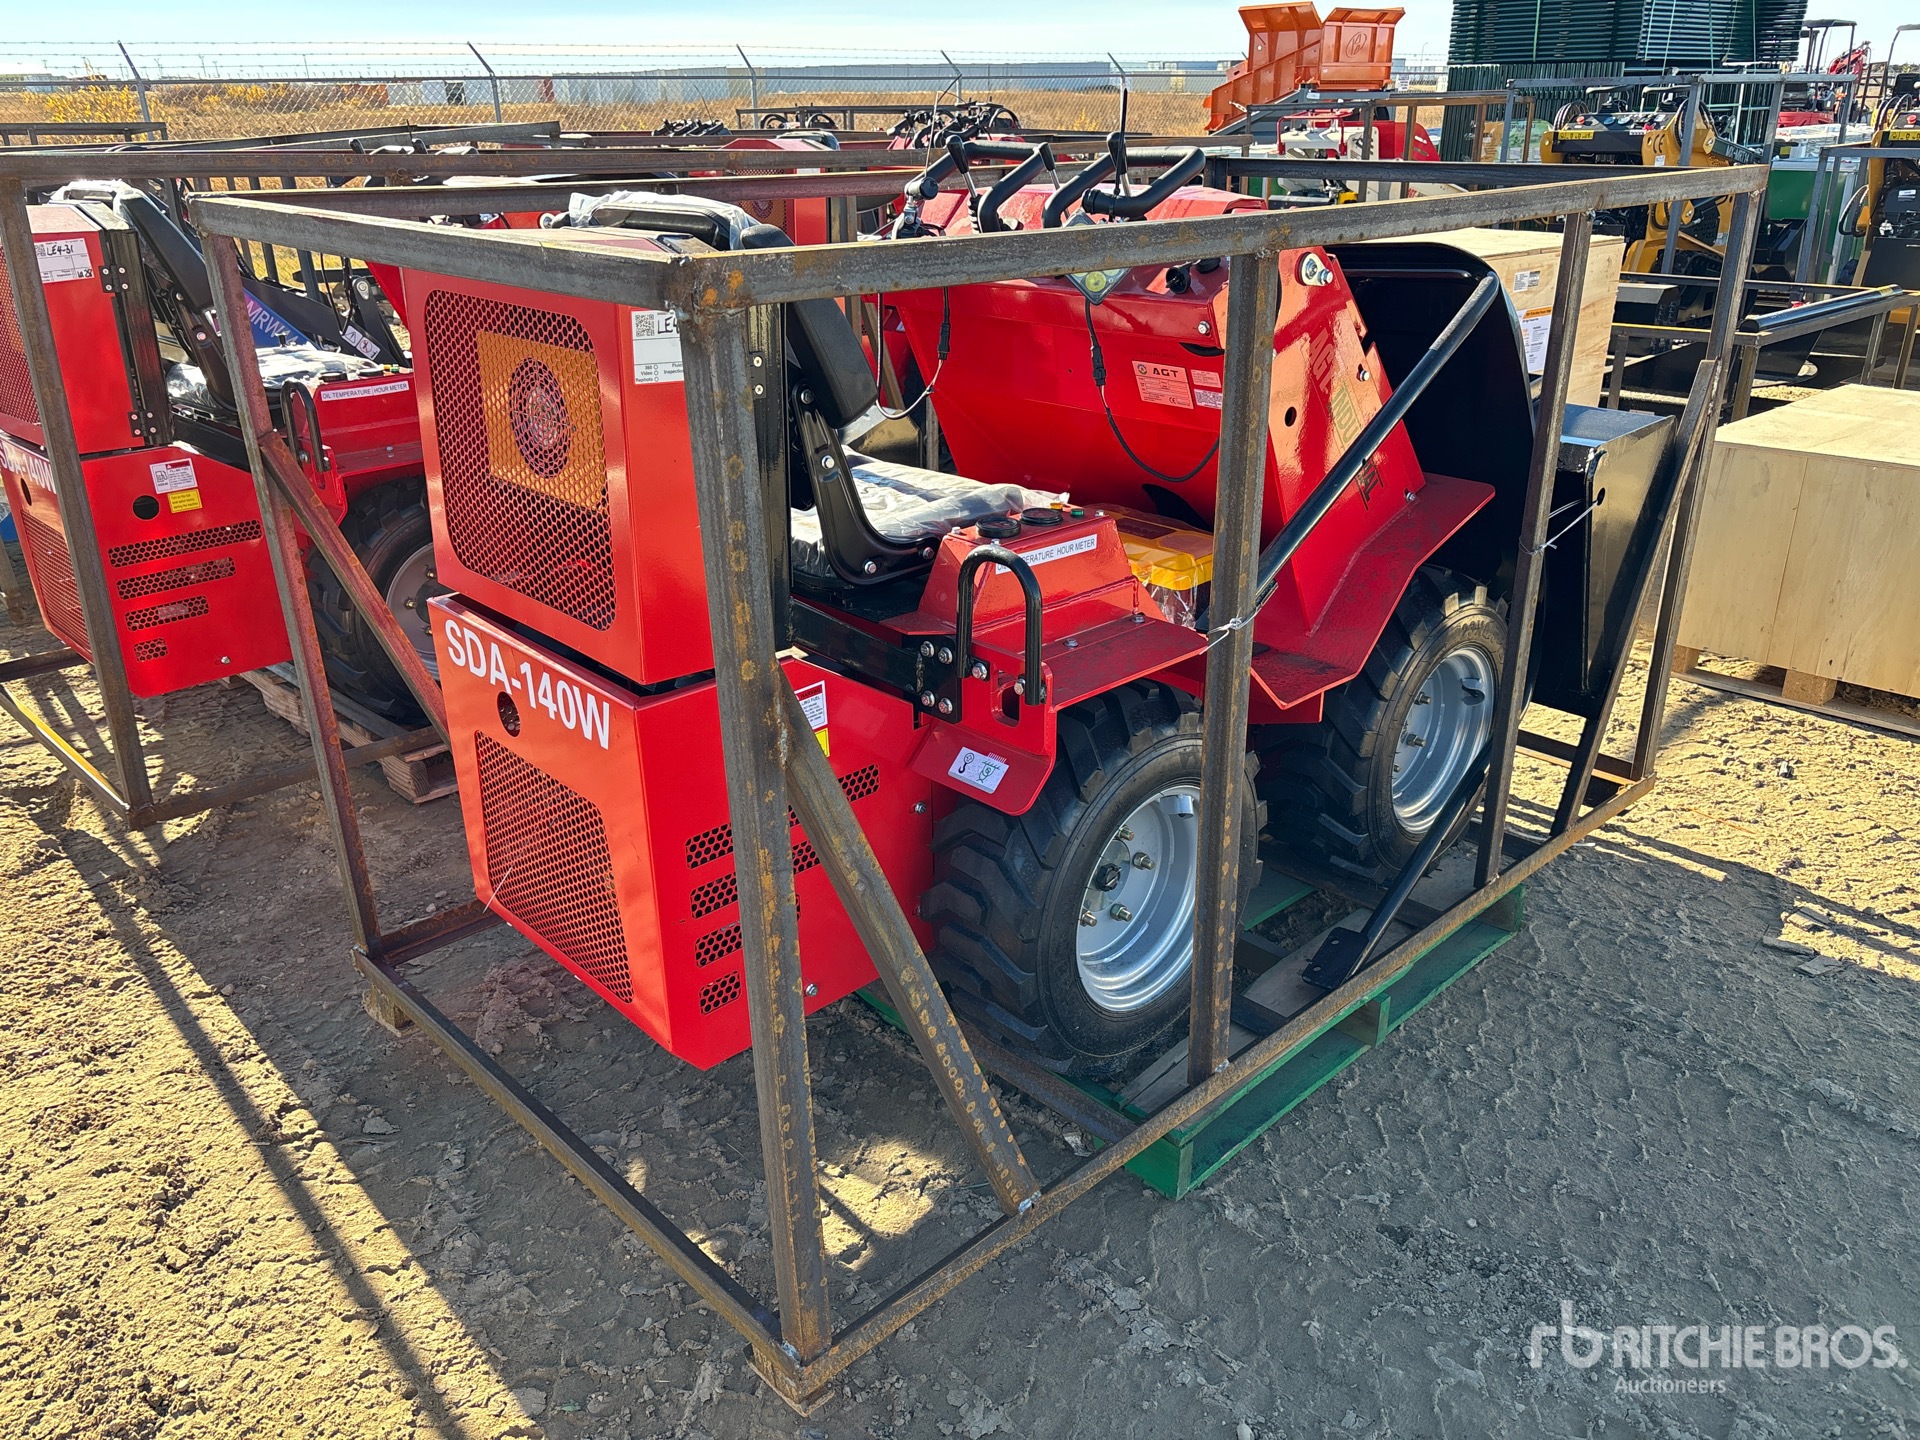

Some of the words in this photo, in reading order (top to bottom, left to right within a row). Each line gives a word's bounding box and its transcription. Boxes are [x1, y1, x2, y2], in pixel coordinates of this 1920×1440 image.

[1152, 367, 1178, 378] AGT
[322, 392, 333, 400] OIL
[333, 388, 372, 399] TEMPERATURE
[373, 385, 389, 394] HOUR
[389, 382, 408, 392] METER
[1056, 544, 1075, 556] HOUR
[1074, 538, 1095, 551] METER
[445, 619, 610, 750] SDA-140W
